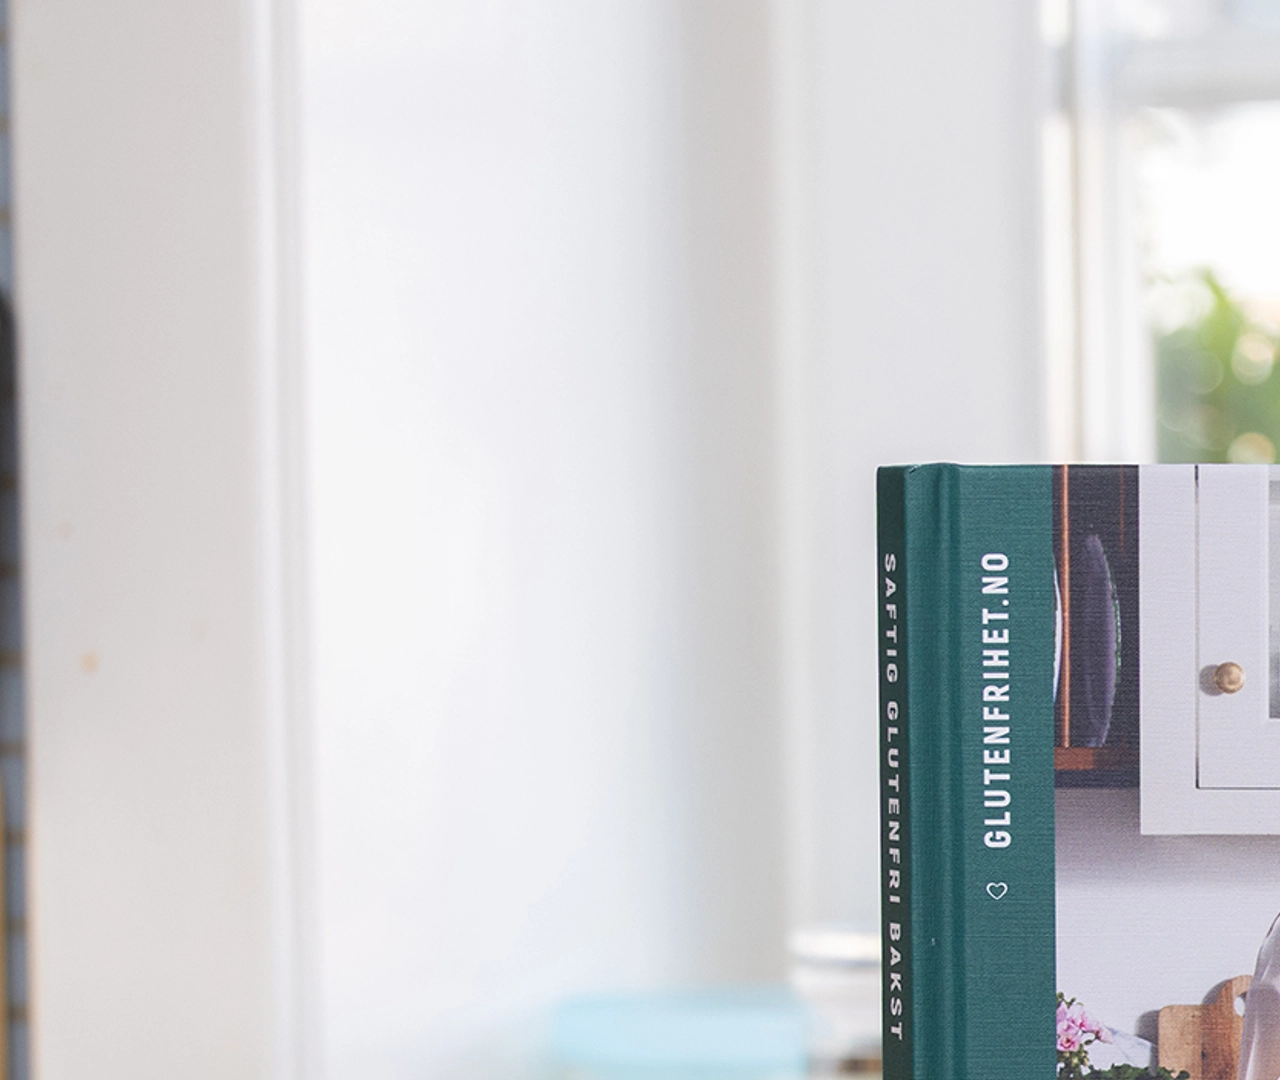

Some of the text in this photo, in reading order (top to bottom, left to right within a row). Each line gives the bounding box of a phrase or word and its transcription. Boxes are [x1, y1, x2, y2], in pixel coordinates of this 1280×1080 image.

[885, 552, 903, 1041] SAFTIG GLUTENFRI BAKST
[981, 552, 1012, 849] GLUTENFRIHET.NO
